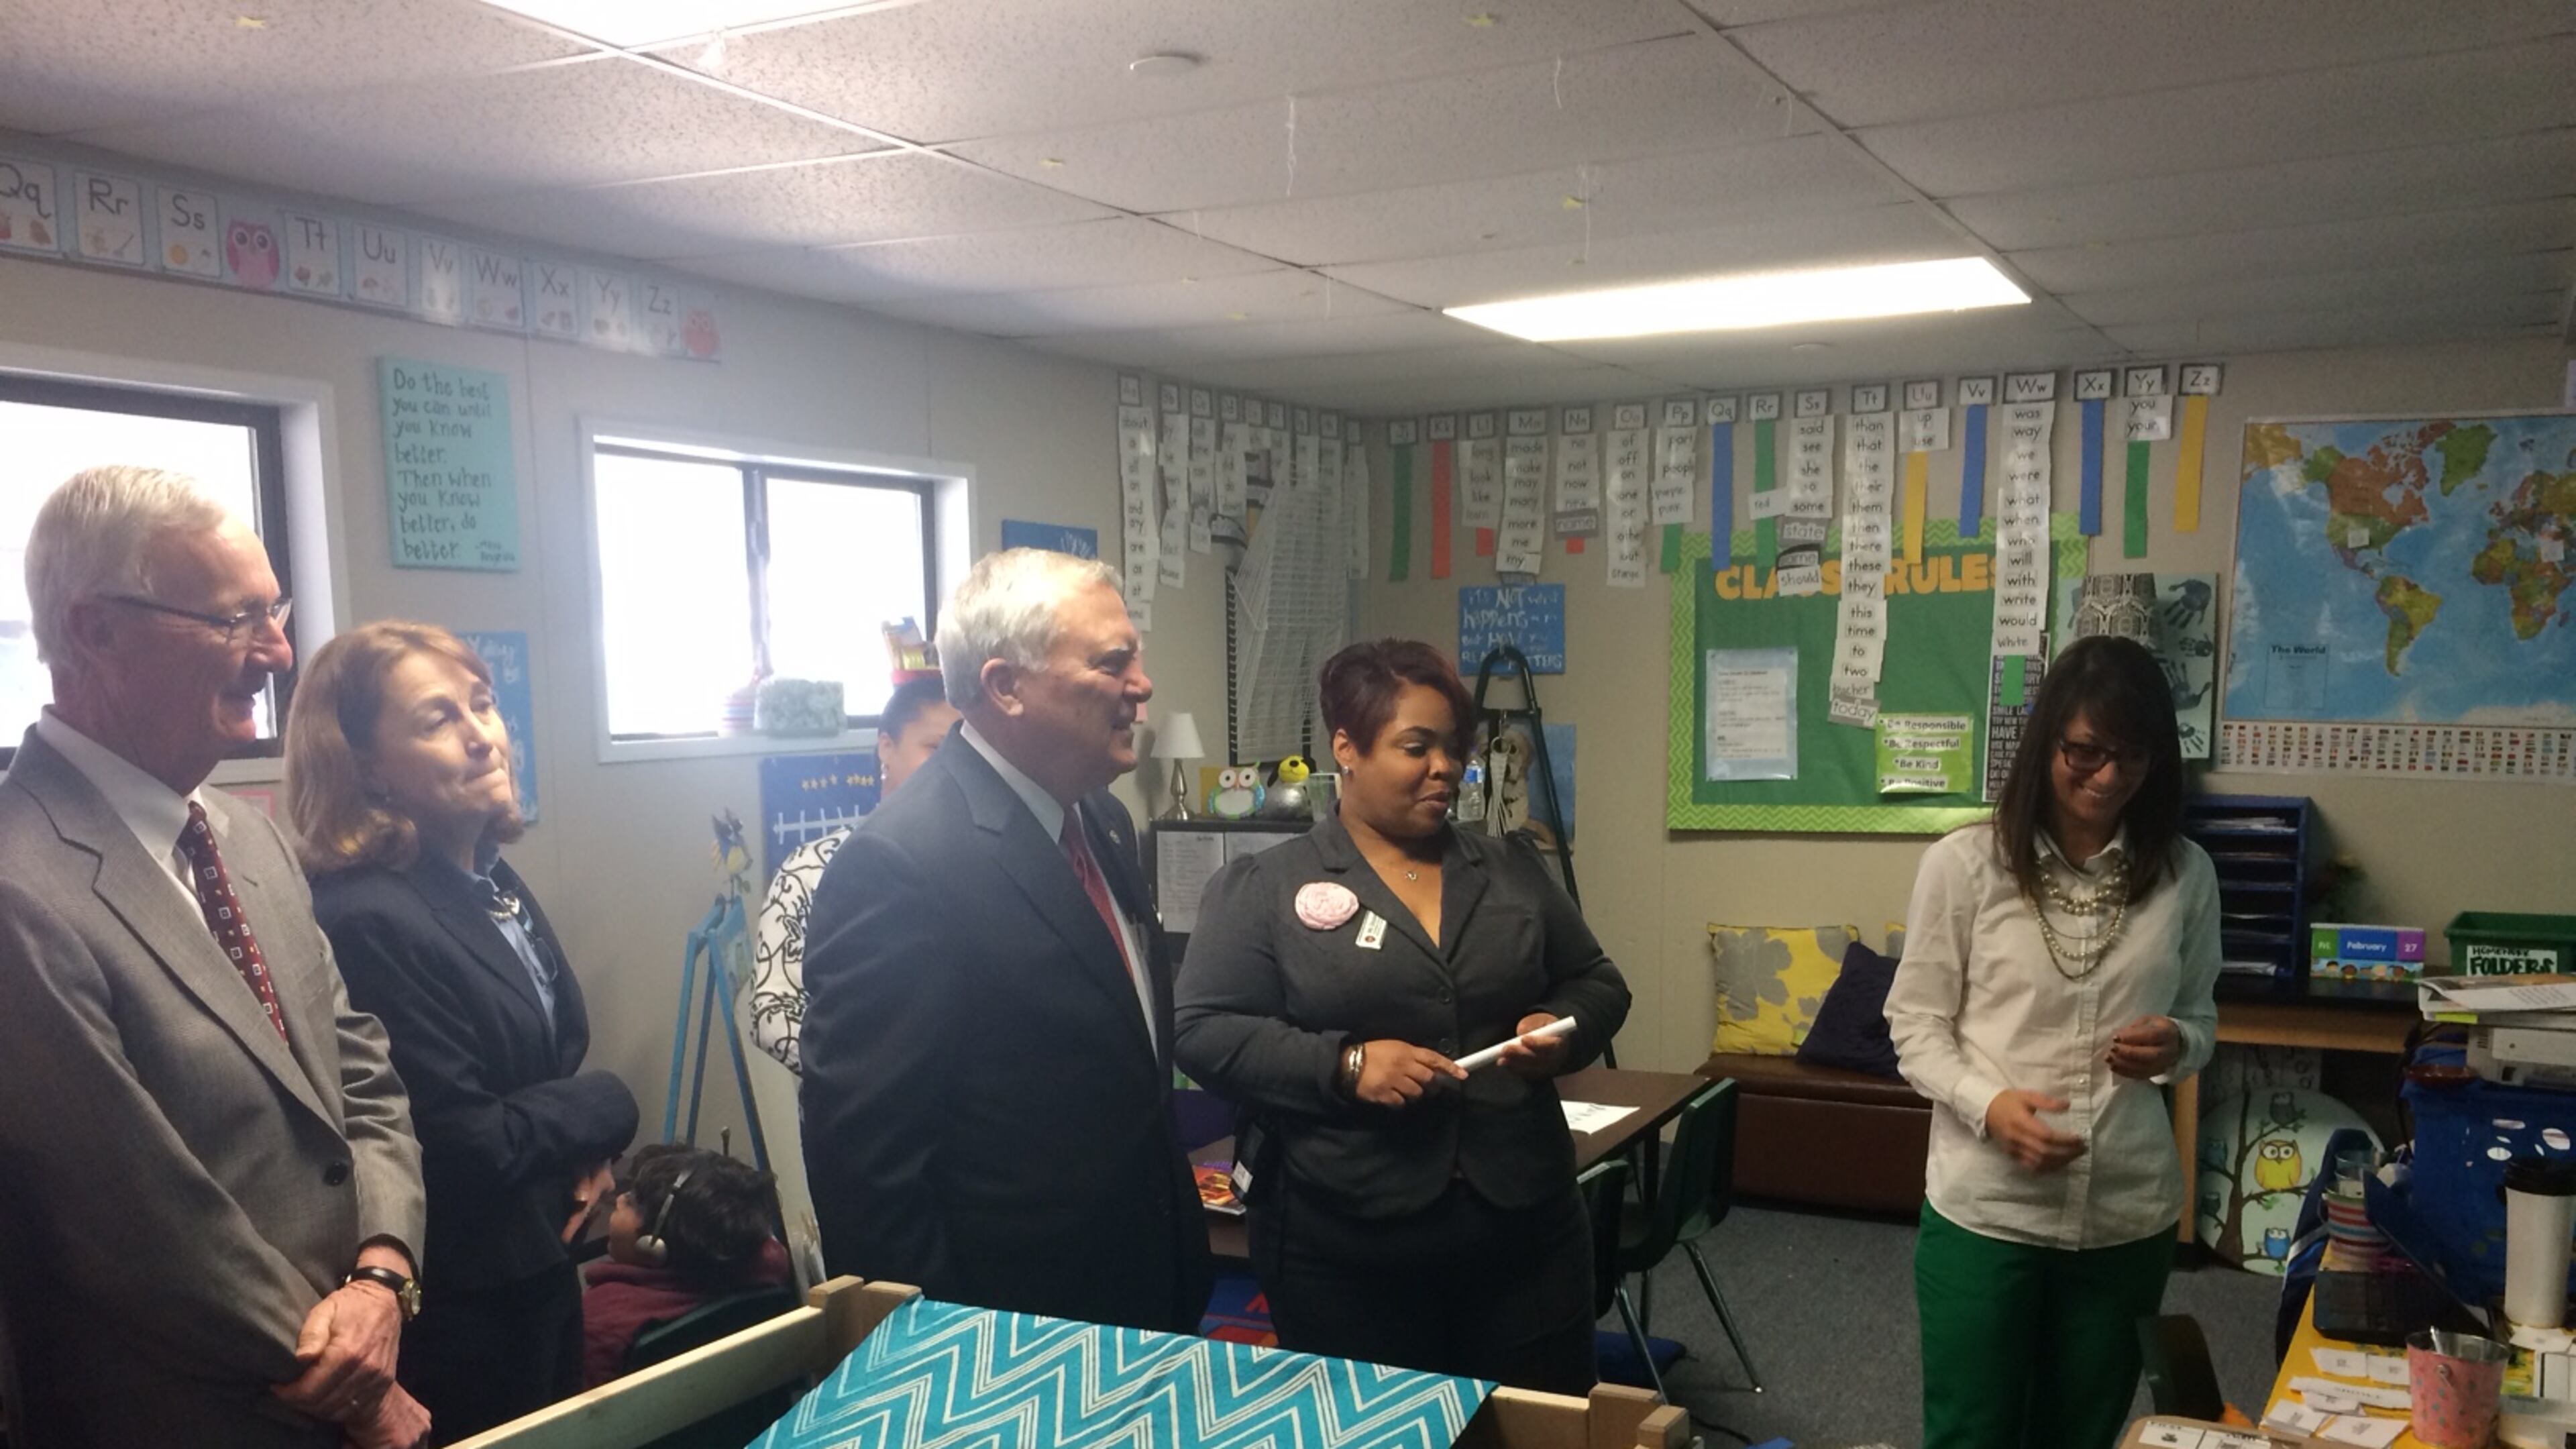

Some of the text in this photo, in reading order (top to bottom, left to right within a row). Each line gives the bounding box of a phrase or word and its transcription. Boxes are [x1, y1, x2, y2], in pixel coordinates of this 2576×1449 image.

[89, 178, 128, 216] Rr
[171, 194, 206, 231] Ss
[294, 217, 327, 252] Tt
[362, 233, 396, 264] Uu
[428, 243, 453, 274] Vv
[476, 254, 517, 288] Ww
[540, 268, 570, 298] Xx
[596, 276, 621, 315] Yy
[648, 286, 671, 315] Zz
[392, 368, 490, 400] Do the best
[2084, 377, 2104, 393] Xx
[2135, 374, 2155, 390] Yy
[2190, 370, 2211, 387] Zz
[1967, 383, 1986, 398] Vv
[2015, 378, 2047, 394] Ww
[1862, 390, 1878, 405] Tt
[1913, 387, 1933, 401] Uu
[392, 398, 418, 417] you
[423, 400, 451, 416] can
[1755, 398, 1773, 413] Rr
[1805, 397, 1820, 411] Ss
[2131, 399, 2156, 415] you
[1671, 406, 1688, 421] Pp
[1711, 403, 1733, 421] Qq
[2015, 409, 2041, 419] was
[1800, 421, 1825, 434] said
[1856, 418, 1884, 431] than
[1917, 413, 1932, 430] up
[392, 419, 472, 439] you know
[2012, 425, 2042, 441] way
[2127, 421, 2157, 437] your
[1621, 433, 1635, 447] of
[1857, 439, 1882, 451] that
[1914, 435, 1934, 446] use
[1802, 442, 1822, 453] see
[1619, 451, 1638, 466] off
[2017, 450, 2035, 460] we
[1801, 464, 1821, 476] she
[1859, 459, 1879, 472] the
[396, 466, 492, 488] Then when
[1621, 470, 1635, 480] on
[2008, 470, 2040, 482] were
[1564, 478, 1588, 489] now
[1854, 480, 1882, 492] their
[397, 490, 428, 513] you
[1618, 490, 1638, 501] one
[2006, 494, 2040, 506] what
[1792, 501, 1825, 512] some
[1852, 501, 1882, 513] them
[460, 512, 477, 530] do
[1508, 519, 1538, 530] more
[2003, 512, 2039, 526] when
[1786, 522, 1825, 539] state
[1851, 521, 1880, 534] then
[1511, 538, 1529, 548] me
[1849, 540, 1882, 553] there
[1507, 554, 1525, 568] my
[1848, 559, 1882, 572] these
[2009, 551, 2033, 566] will
[1715, 553, 1996, 600] CLS RULE
[2006, 573, 2035, 586] with
[1847, 579, 1877, 597] they
[1496, 588, 1525, 610] NOT
[2003, 593, 2037, 606] write
[1850, 605, 1873, 619] this
[1998, 614, 2037, 627] would
[1846, 625, 1876, 637] time
[1851, 644, 1866, 657] to
[2271, 645, 2326, 655] The World
[1843, 664, 1868, 677] two
[1832, 700, 1876, 721] today
[1905, 718, 1966, 731] Responsible
[1991, 726, 2017, 740] HAVE
[1905, 739, 1960, 750] Respectful
[1900, 759, 1939, 769] Be Kind
[2347, 941, 2387, 953] February
[2404, 943, 2418, 953] 27
[2469, 956, 2555, 976] FOLDERS
